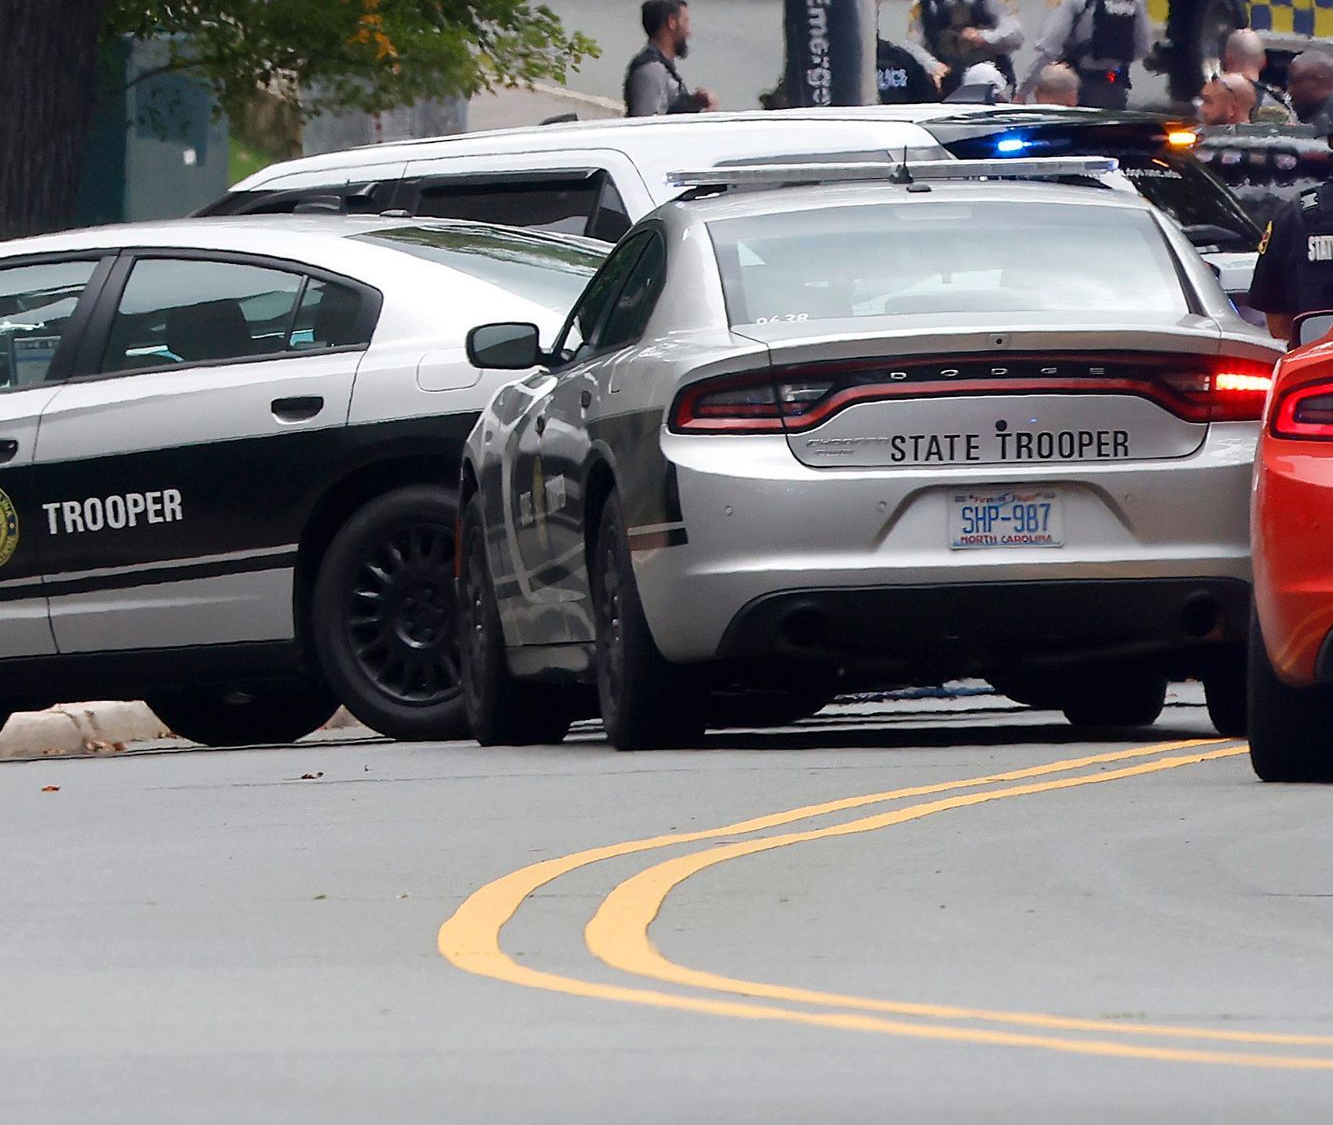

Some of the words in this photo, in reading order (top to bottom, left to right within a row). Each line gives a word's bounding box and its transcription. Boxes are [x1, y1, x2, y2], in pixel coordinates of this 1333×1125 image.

[891, 434, 980, 462] STATE
[996, 430, 1129, 460] TROOPER
[42, 489, 183, 535] TROOPER
[962, 503, 1051, 533] SHP-987
[961, 535, 997, 544] NORTH
[1001, 534, 1053, 544] CAROLINA
